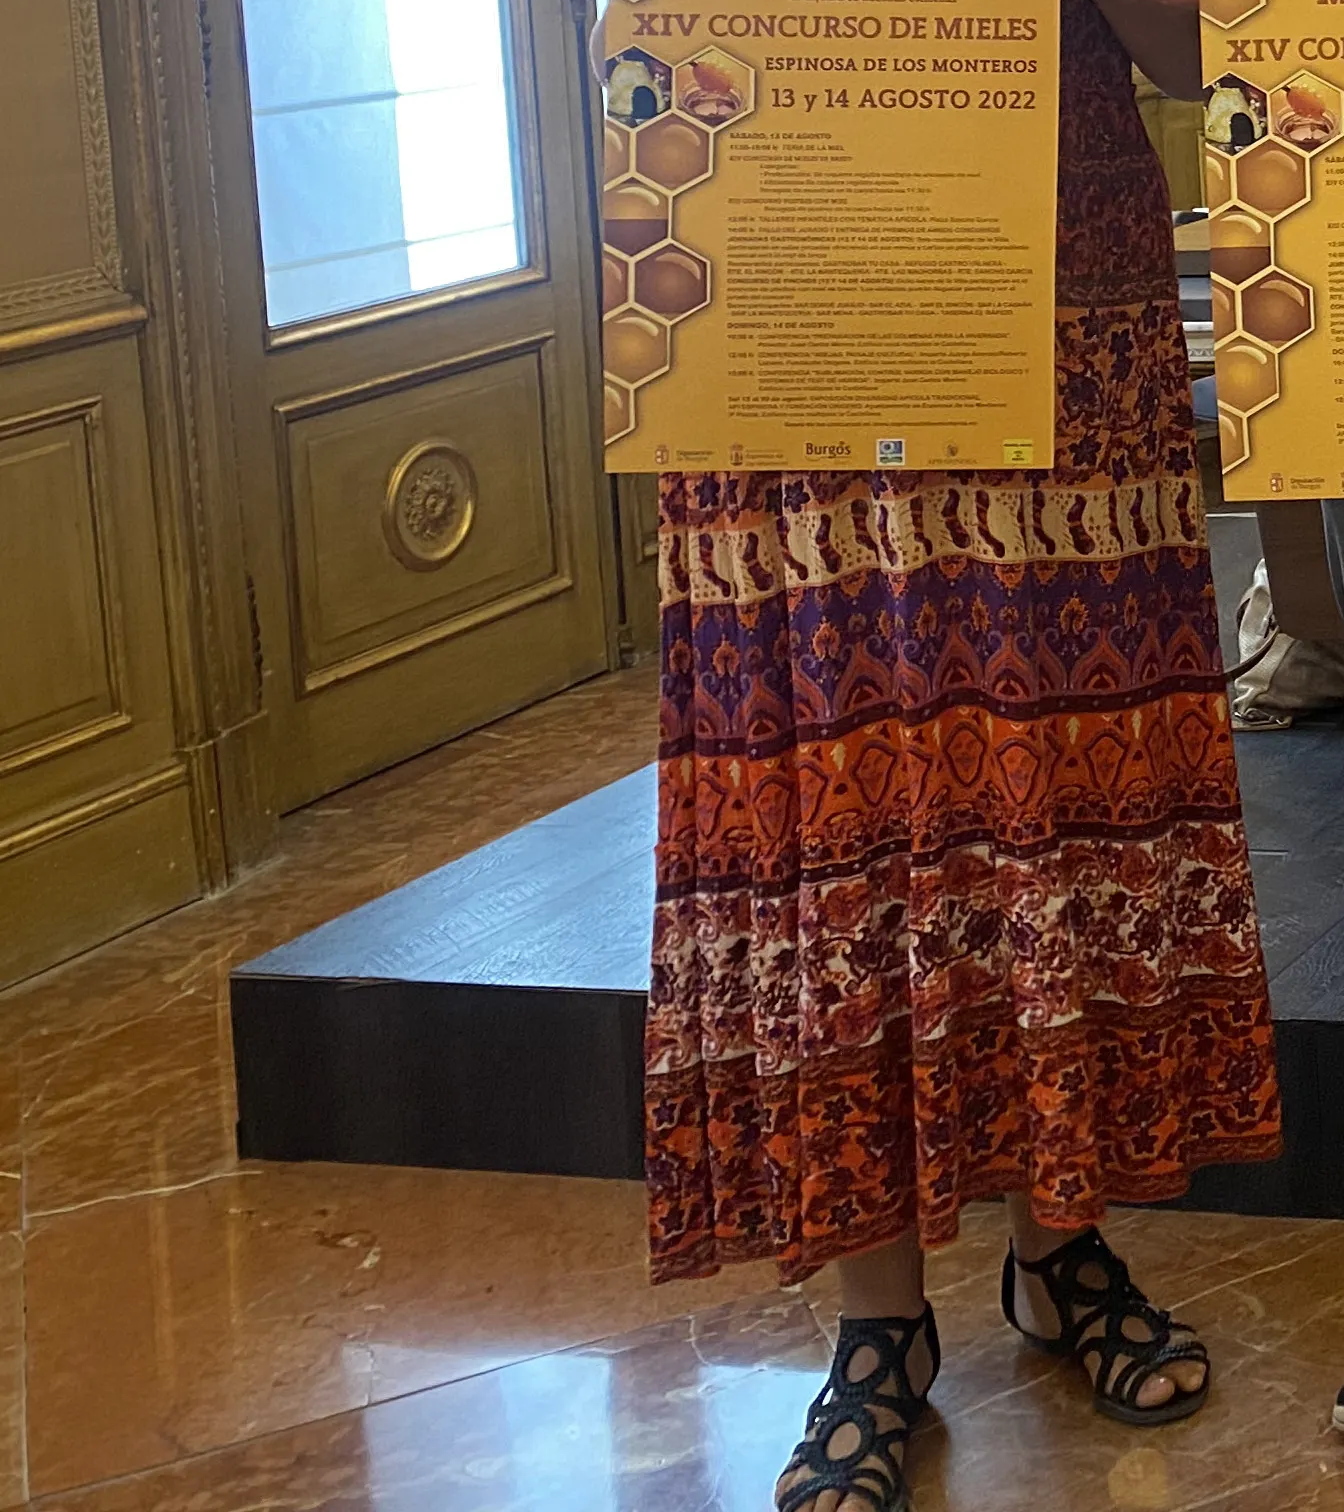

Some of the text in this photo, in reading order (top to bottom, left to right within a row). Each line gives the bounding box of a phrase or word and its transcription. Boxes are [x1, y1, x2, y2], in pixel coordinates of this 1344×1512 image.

[632, 13, 1037, 41] XIV CONCURSO DE MIELES
[1226, 38, 1291, 62] XIV
[765, 57, 1037, 73] ESPINOSA DE LOS MONTEROS
[771, 88, 1036, 113] 13 y 14 AGOSTO 2022
[806, 441, 851, 459] Burgos
